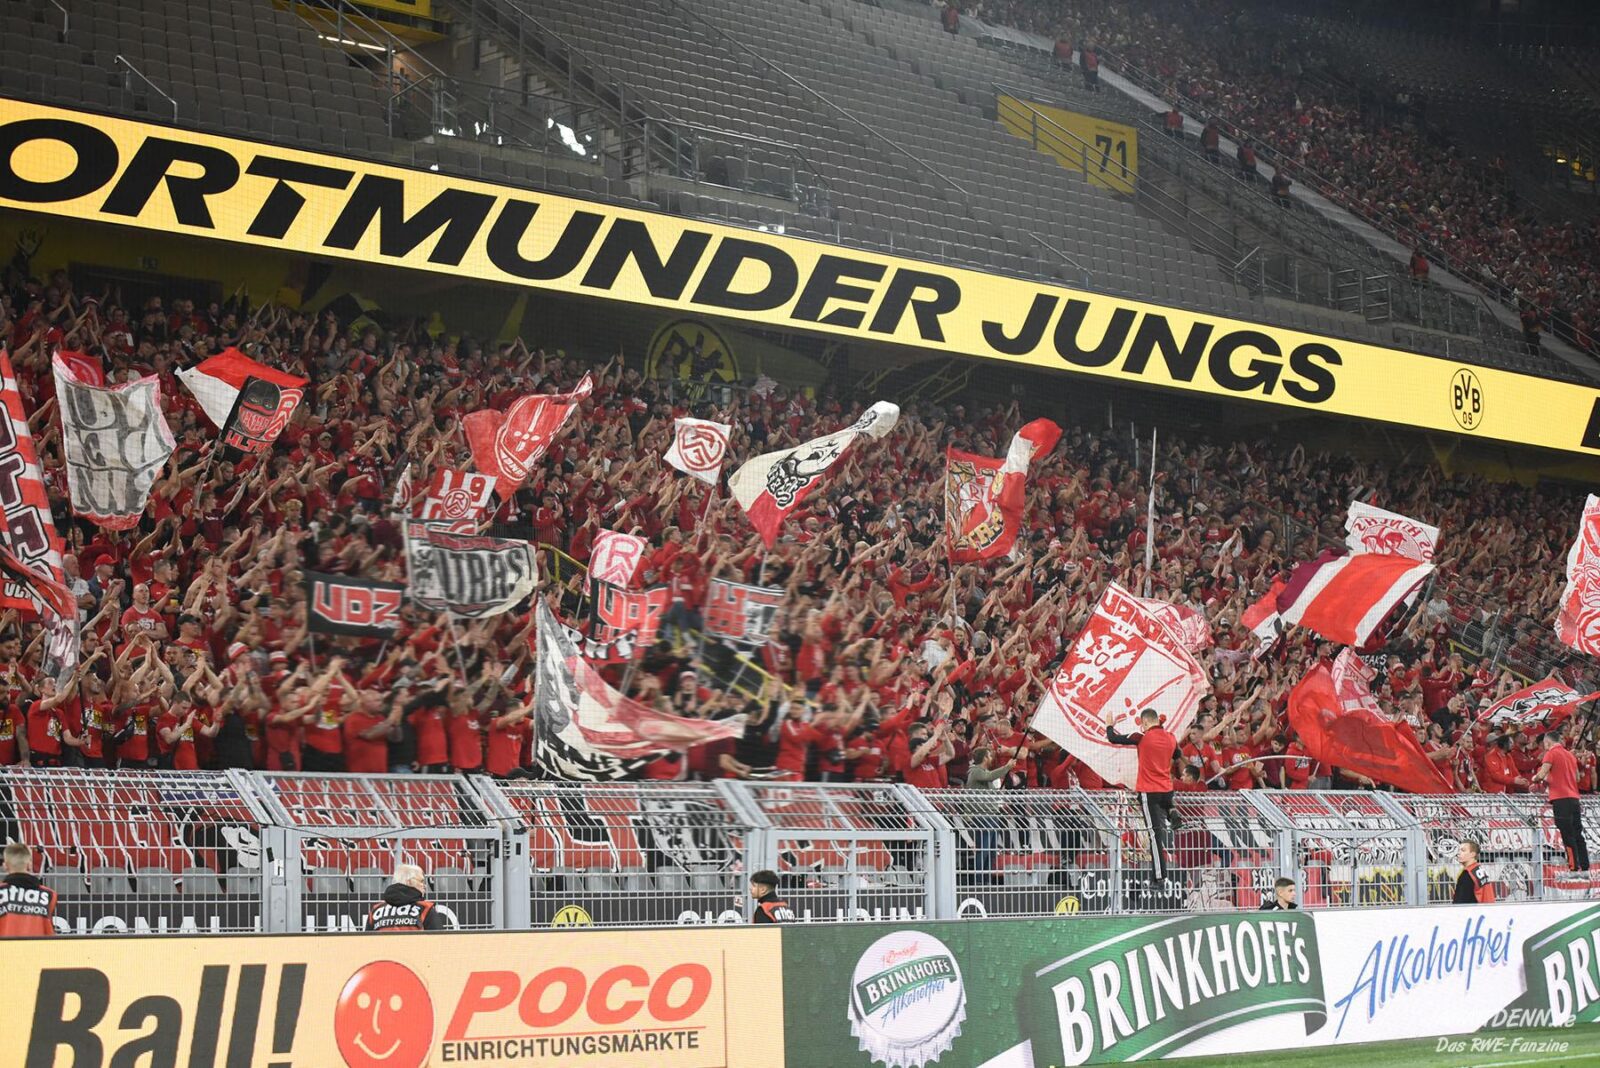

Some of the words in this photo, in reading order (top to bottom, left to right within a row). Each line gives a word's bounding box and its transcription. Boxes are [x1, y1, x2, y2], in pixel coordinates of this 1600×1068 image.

[1096, 134, 1127, 178] 71
[0, 118, 961, 342] ORTMUNDER
[981, 293, 1343, 403] JUNGS
[1454, 374, 1480, 413] BVB
[1462, 411, 1473, 425] 09
[313, 581, 402, 629] UDZ
[1334, 915, 1514, 1039] Alkoholfrei
[24, 963, 307, 1068] Ball!
[444, 963, 713, 1040] POCO
[442, 1031, 699, 1062] EINRICHTUNGSMÄRKTE
